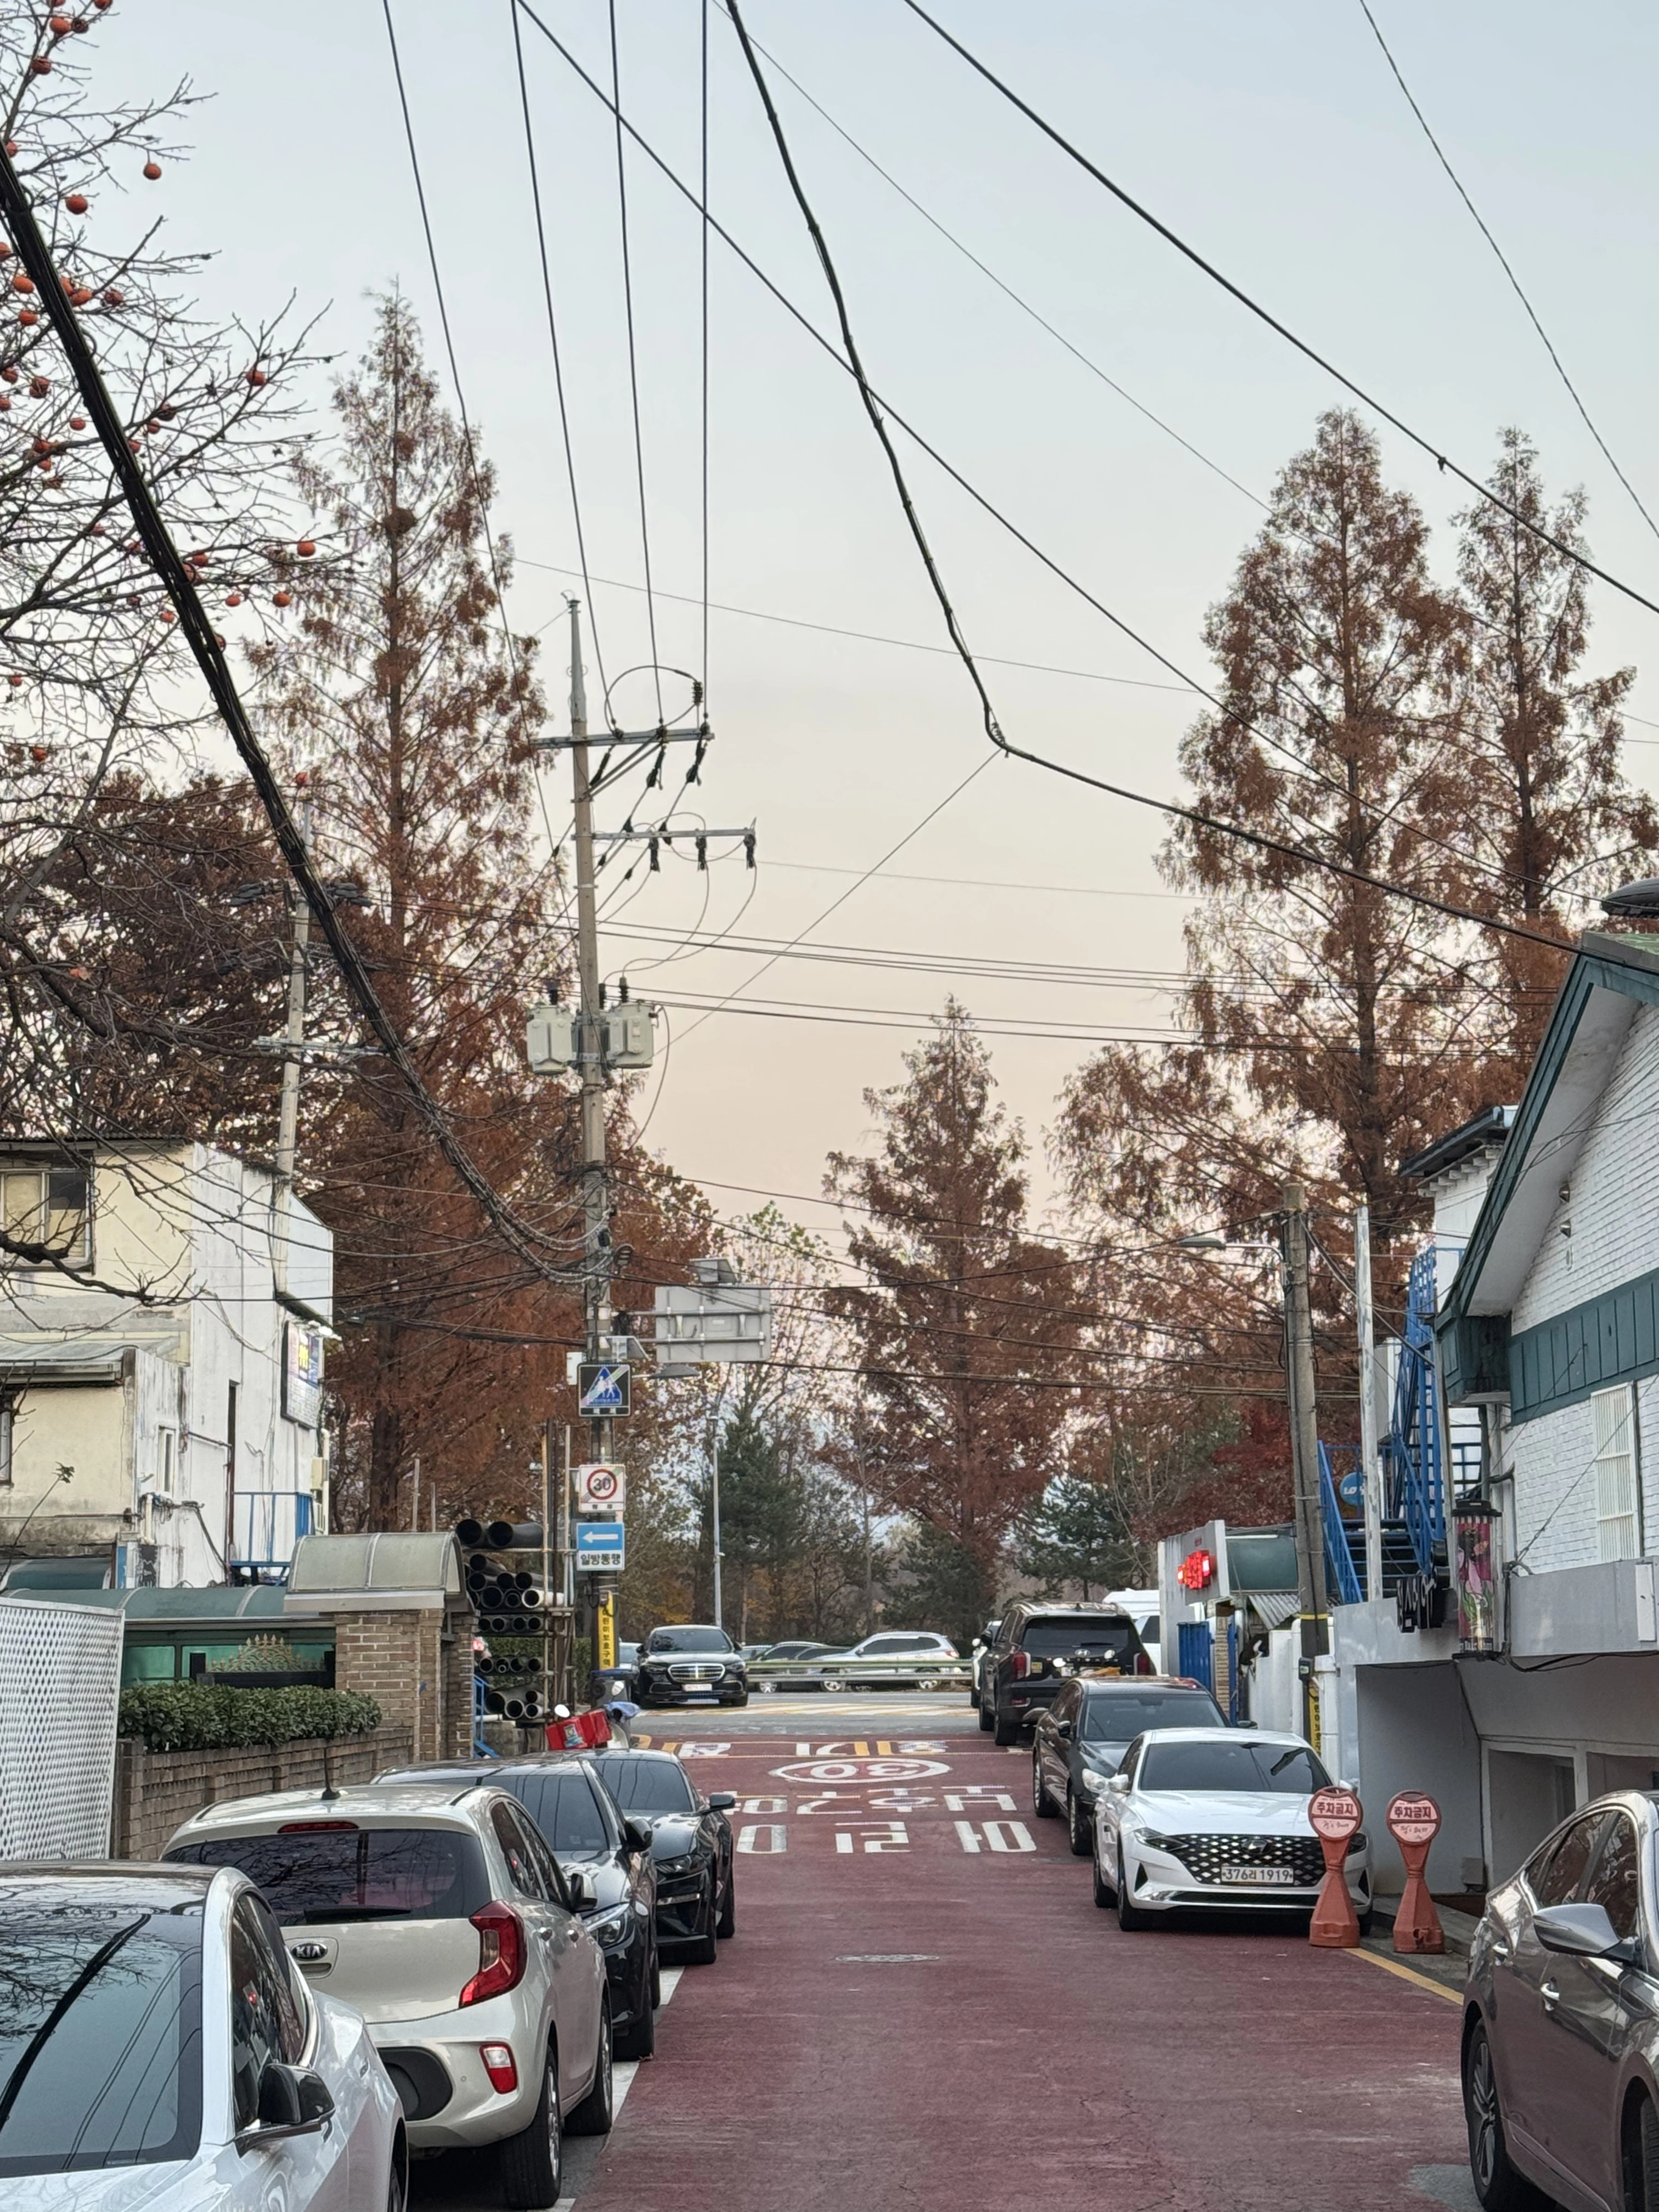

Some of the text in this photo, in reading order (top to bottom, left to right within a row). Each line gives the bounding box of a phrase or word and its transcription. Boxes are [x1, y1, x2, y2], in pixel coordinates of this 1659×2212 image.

[593, 1477, 611, 1491] 30
[580, 1553, 620, 1565] 일방통행
[810, 1763, 922, 1778] 30
[1317, 1802, 1353, 1815] 주차금지
[1394, 1806, 1431, 1819] 주차금지
[1260, 1869, 1290, 1881] 1919
[296, 1945, 321, 1958] KIA
